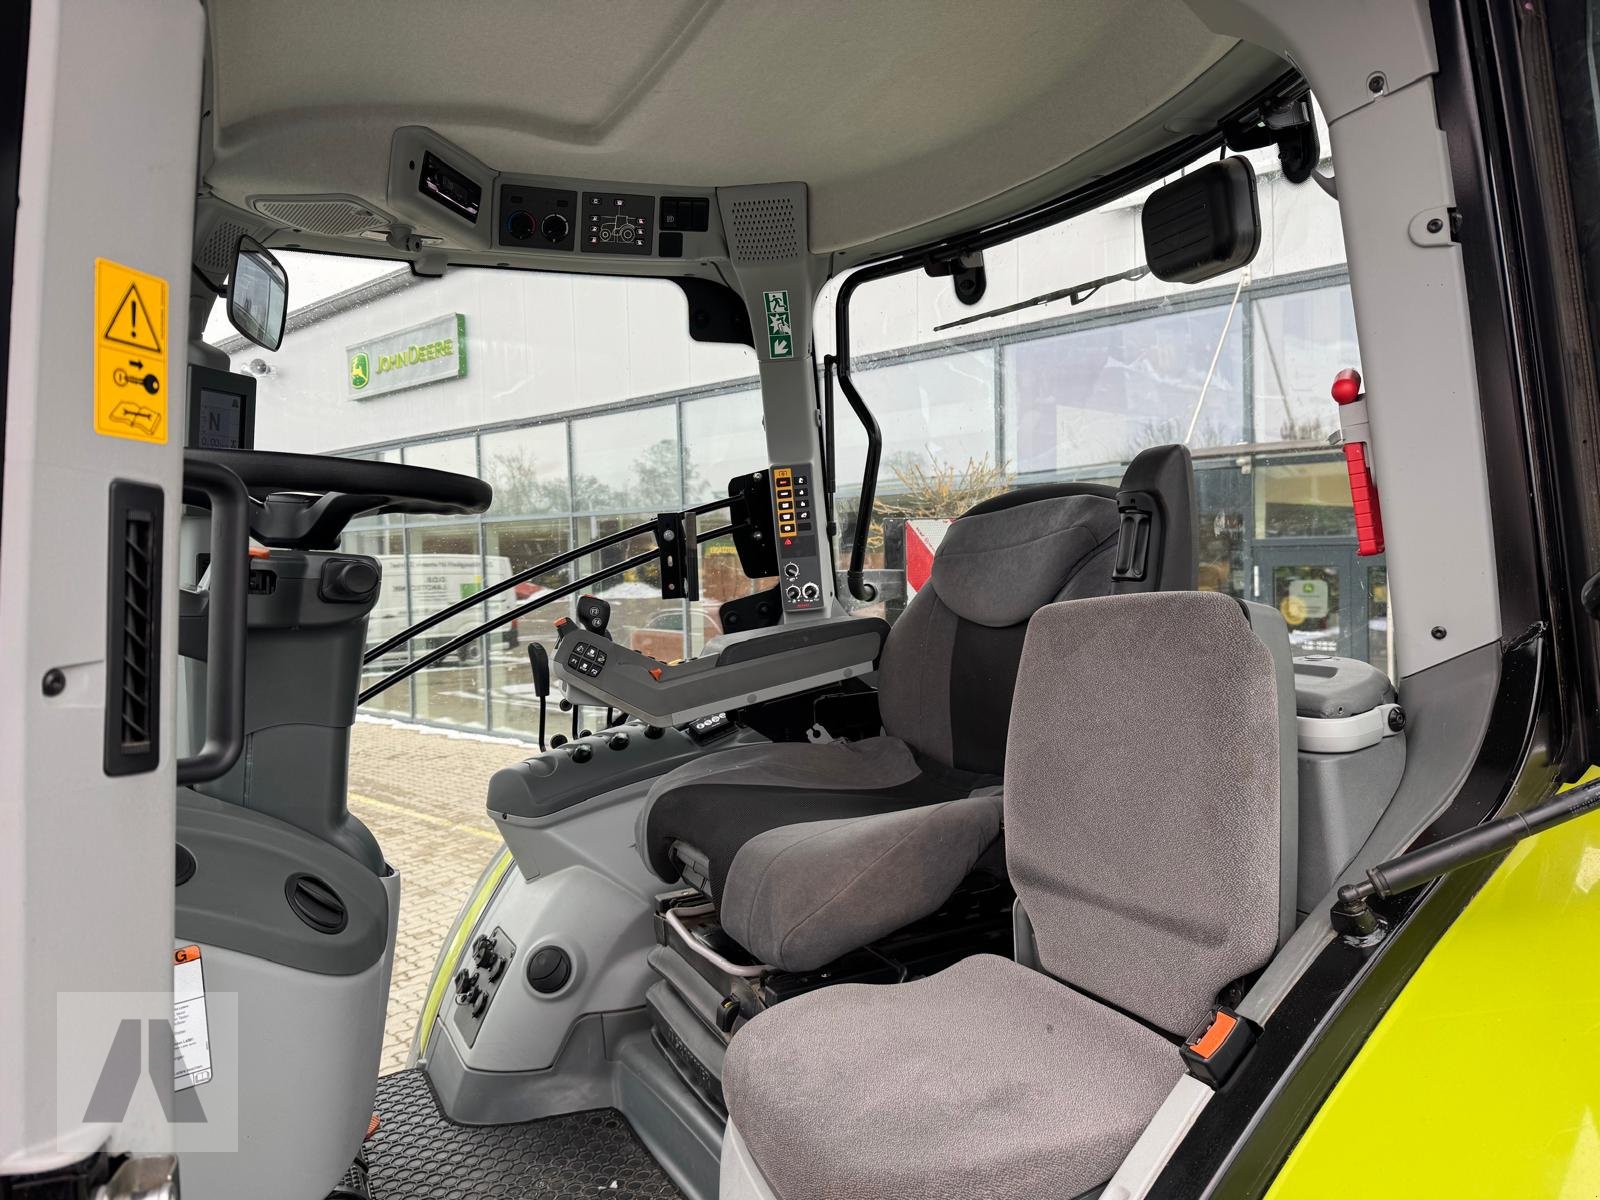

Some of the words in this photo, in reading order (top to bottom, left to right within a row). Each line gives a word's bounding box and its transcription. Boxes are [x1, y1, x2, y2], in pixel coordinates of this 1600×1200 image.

[376, 351, 408, 374] JOHN
[408, 338, 453, 365] DEERE
[209, 412, 220, 431] N
